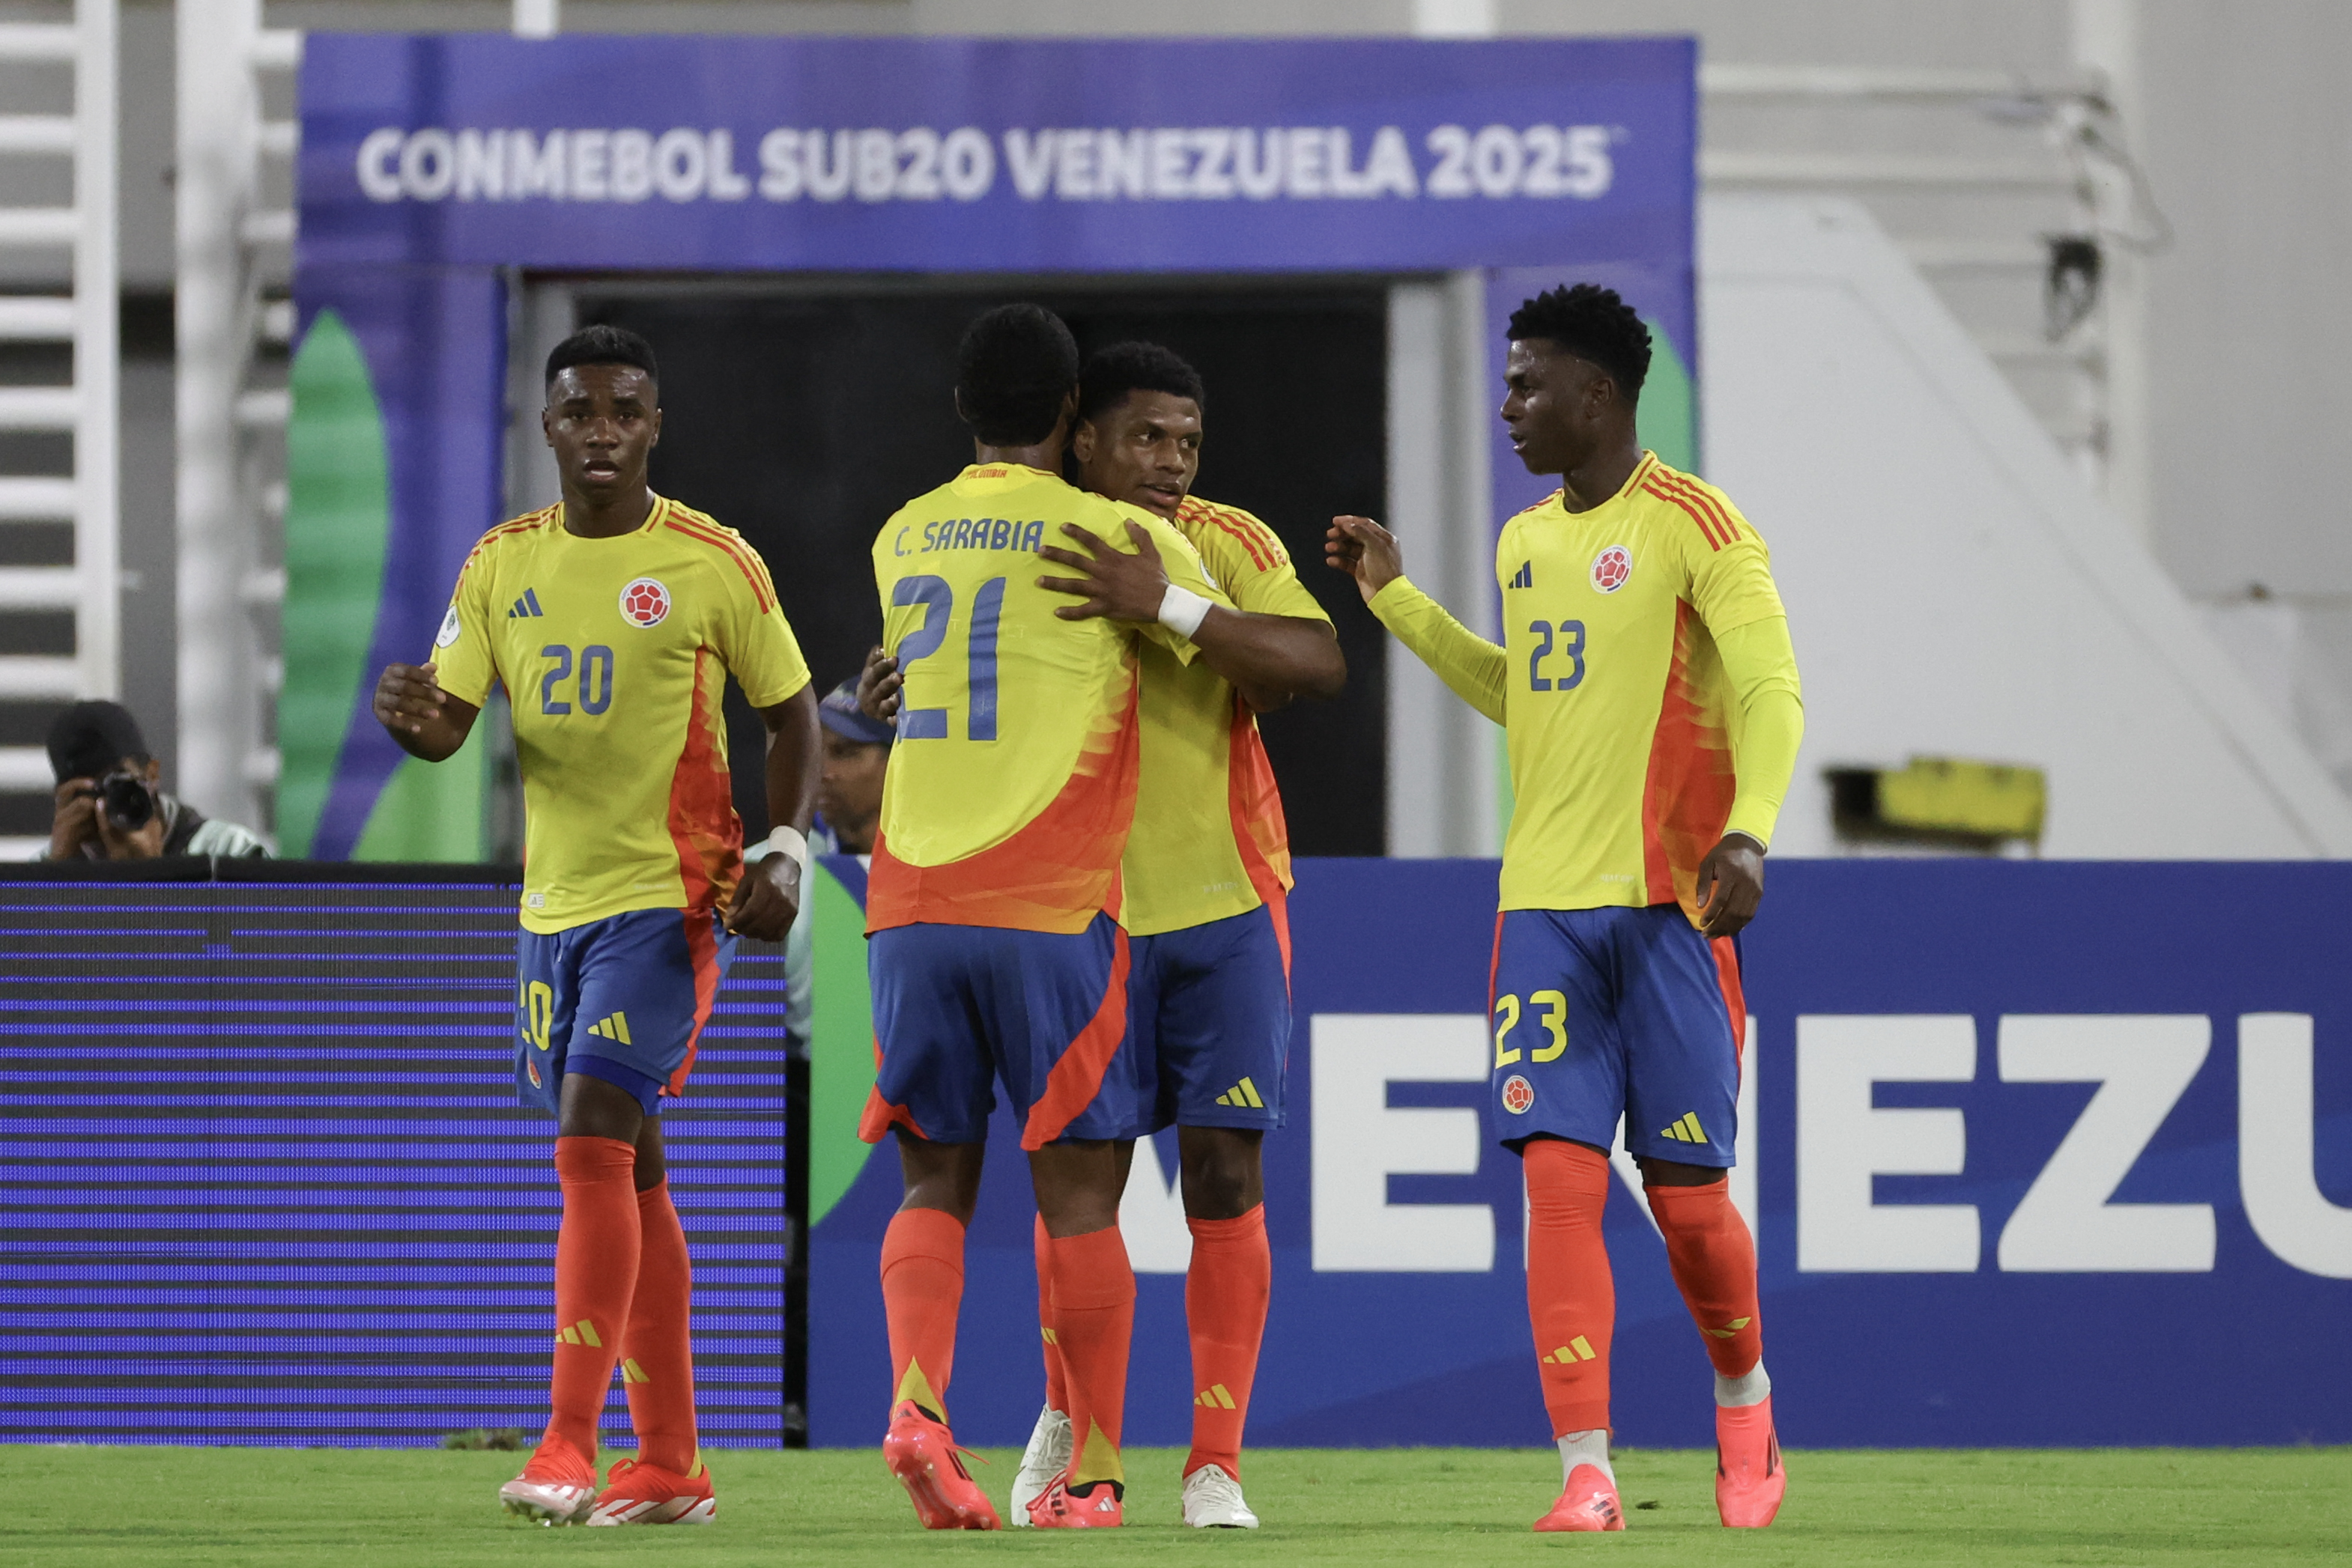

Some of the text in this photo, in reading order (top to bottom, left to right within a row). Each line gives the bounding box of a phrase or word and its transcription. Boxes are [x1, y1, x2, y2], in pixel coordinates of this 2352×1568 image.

[358, 125, 1611, 201] CONMEBOL SUB20 VENEZUELA 2025
[894, 518, 1044, 556] C. SARABIA
[541, 644, 614, 716] 20
[892, 575, 1007, 743] 21
[1529, 620, 1586, 691] 23
[1496, 989, 1568, 1069] 23
[1118, 1012, 2352, 1280] EEZU
